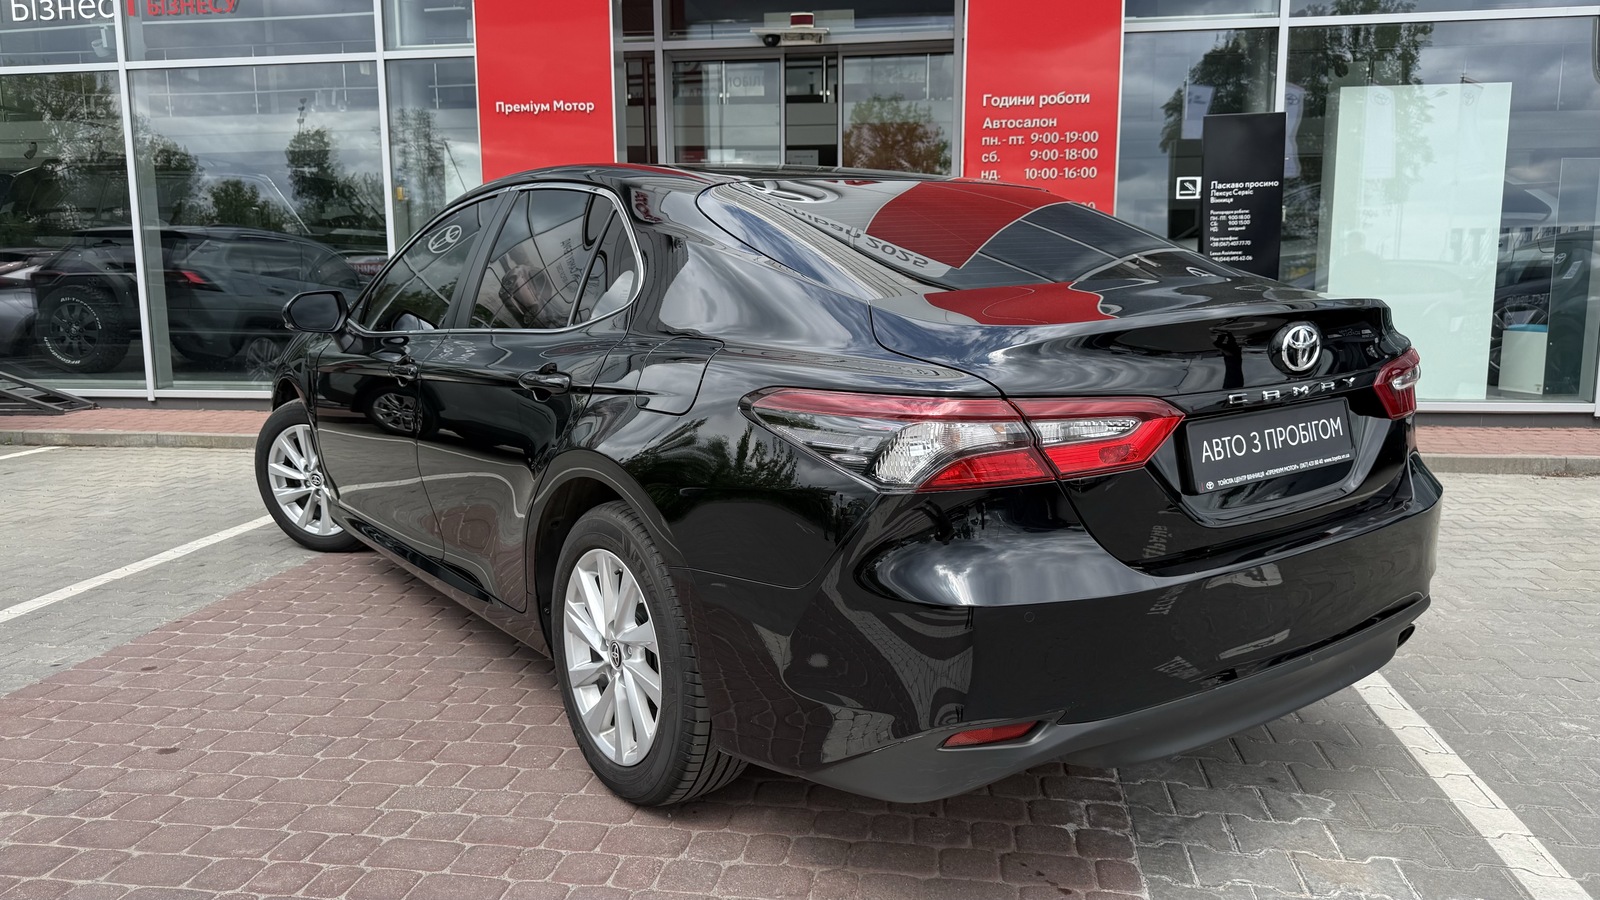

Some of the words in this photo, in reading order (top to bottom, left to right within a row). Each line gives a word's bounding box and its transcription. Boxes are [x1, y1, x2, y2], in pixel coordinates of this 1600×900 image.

[495, 100, 550, 115] Преміум
[553, 99, 595, 114] Мотор
[982, 93, 1035, 108] Години
[1039, 91, 1090, 108] роботи
[982, 117, 1057, 129] Автосалон
[1030, 130, 1099, 144] 9:00-19:00
[981, 151, 1000, 163] сб.
[1029, 147, 1098, 161] 9:00-18:00
[980, 169, 1000, 181] нд.
[1024, 166, 1097, 180] 10:00-16:00
[1210, 180, 1245, 190] Ласкаво
[1245, 180, 1280, 188] просимо
[1228, 377, 1356, 405] CAMRY
[1202, 434, 1247, 463] АВТО
[1250, 431, 1262, 454] З
[1264, 416, 1344, 450] ПРОБІГОМ
